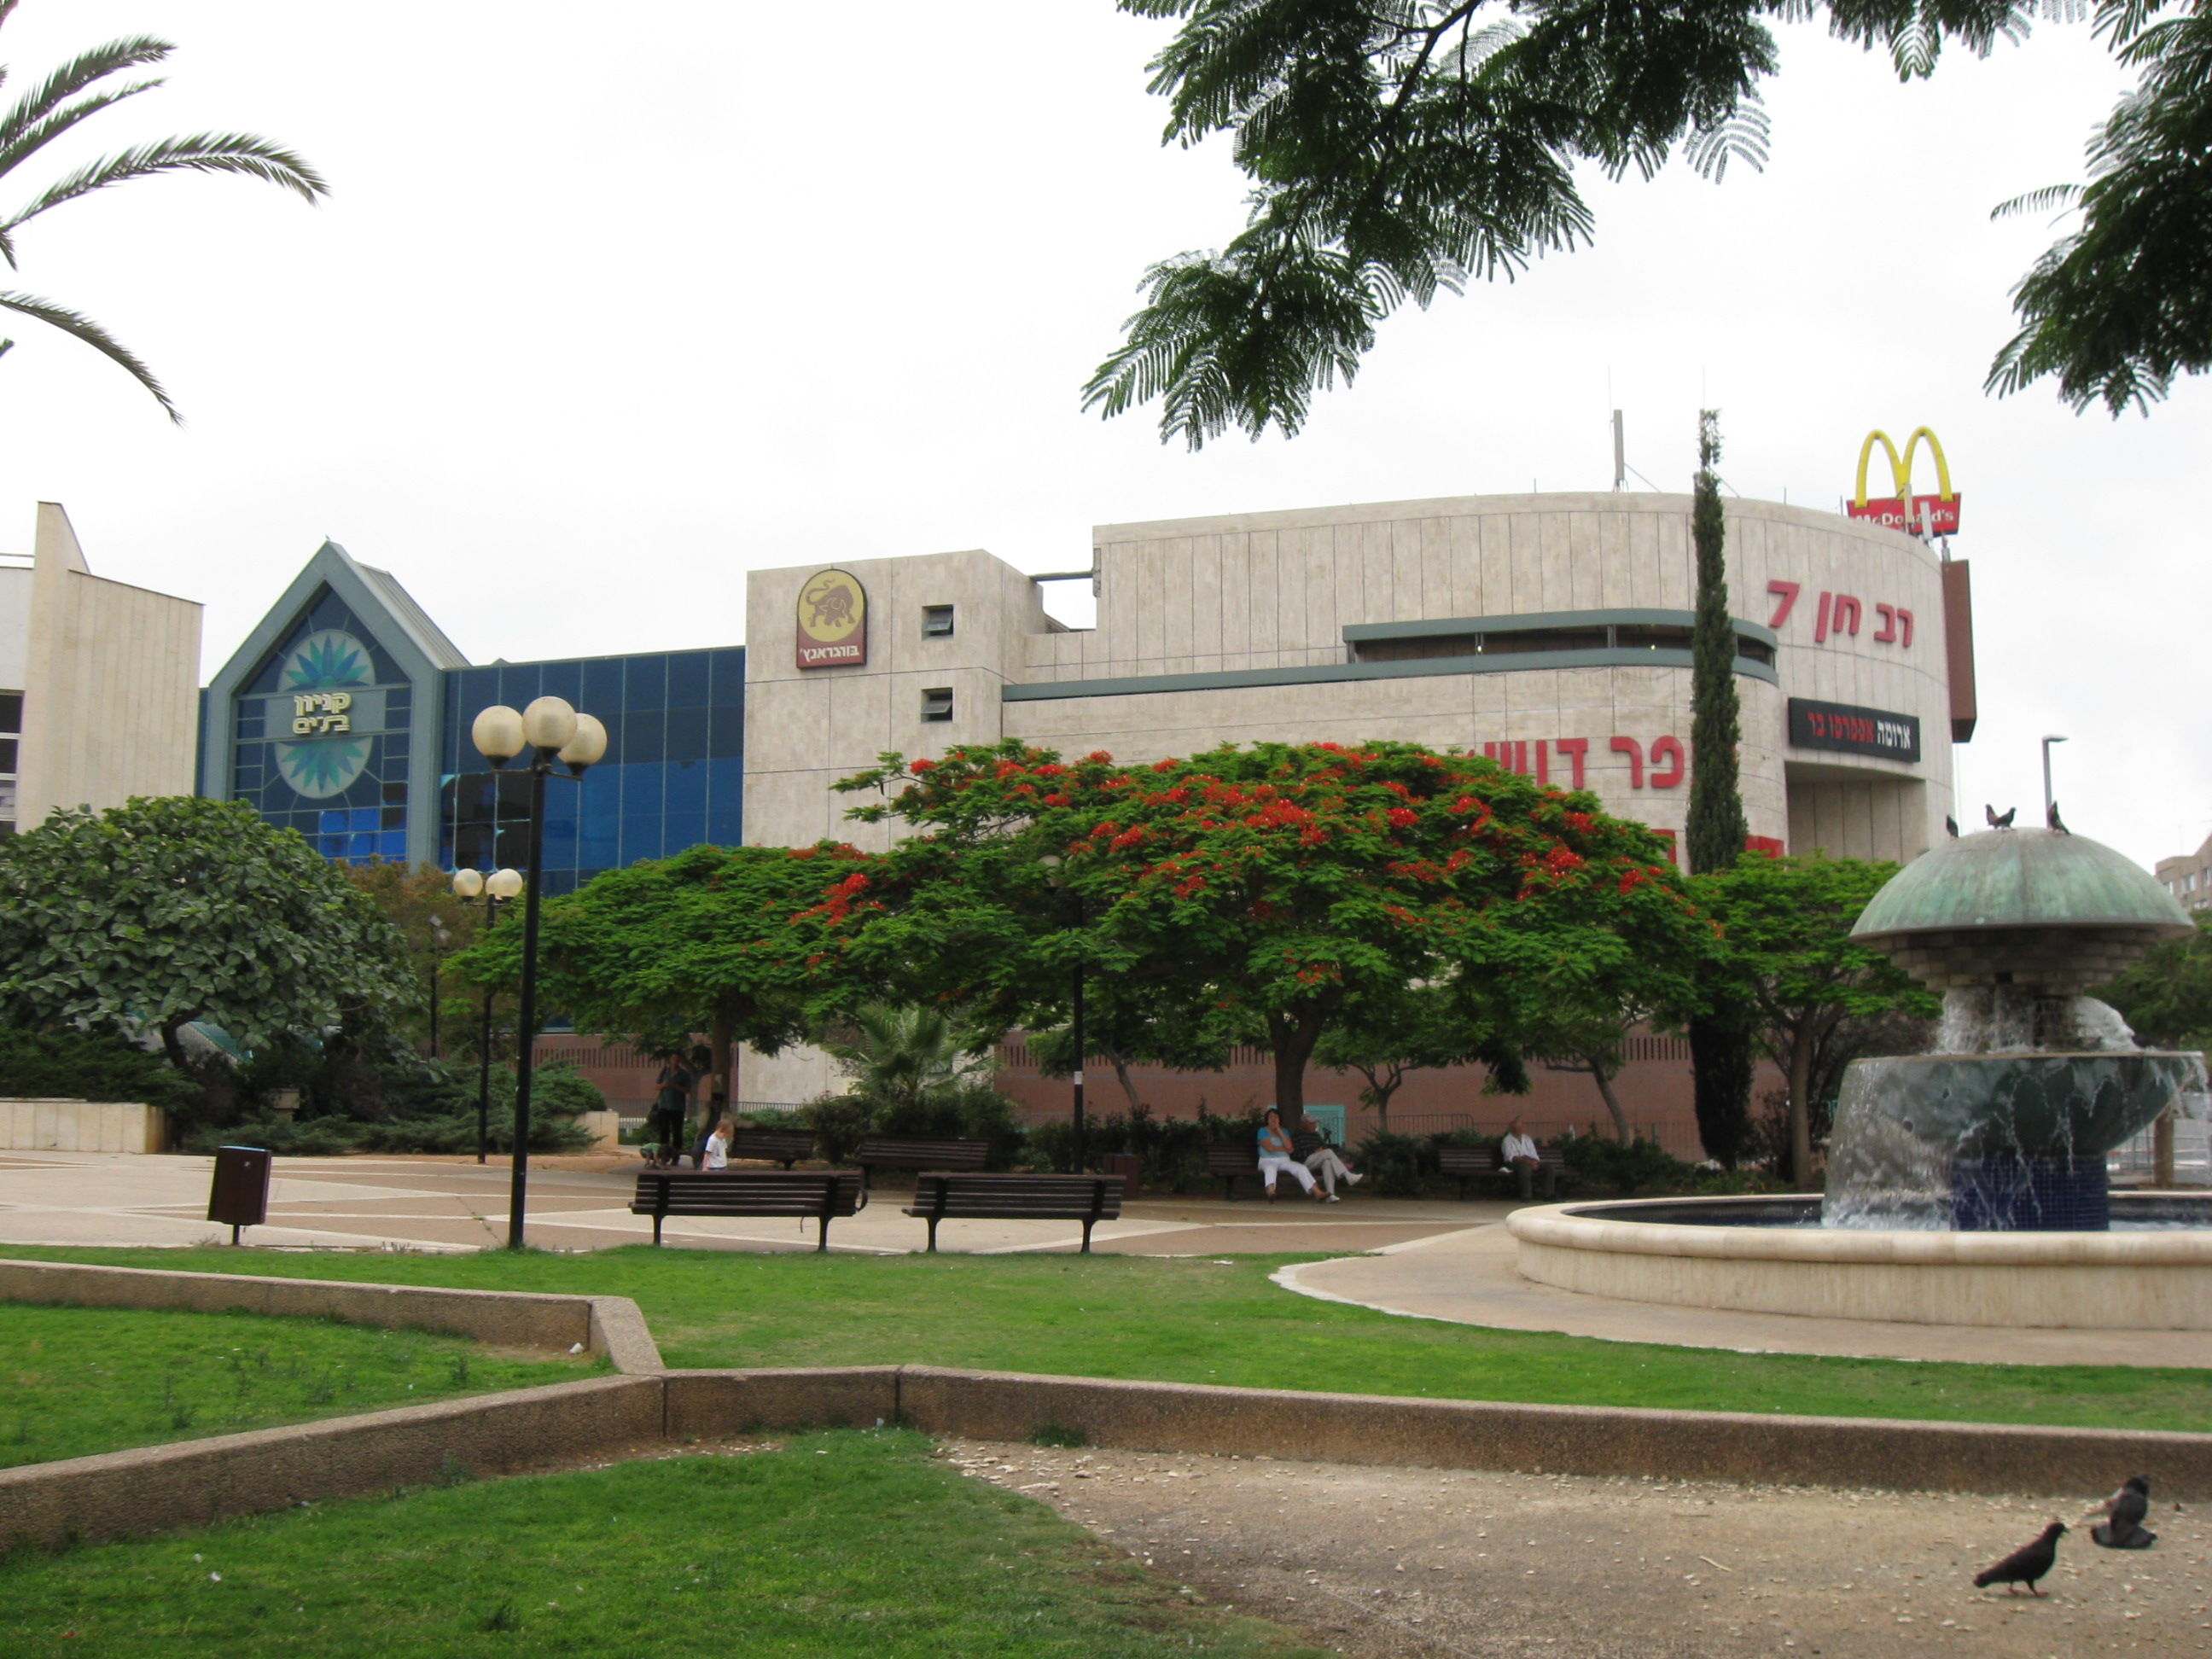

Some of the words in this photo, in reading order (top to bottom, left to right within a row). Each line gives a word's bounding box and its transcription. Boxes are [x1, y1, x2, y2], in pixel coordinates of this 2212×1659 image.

[1767, 579, 1801, 629] 7
[1814, 591, 1862, 643] חן
[1873, 602, 1914, 648] רב
[293, 692, 352, 717] קניון
[1807, 710, 1825, 738] בר
[1828, 713, 1875, 744] אספרסו
[1877, 719, 1911, 750] ארומה
